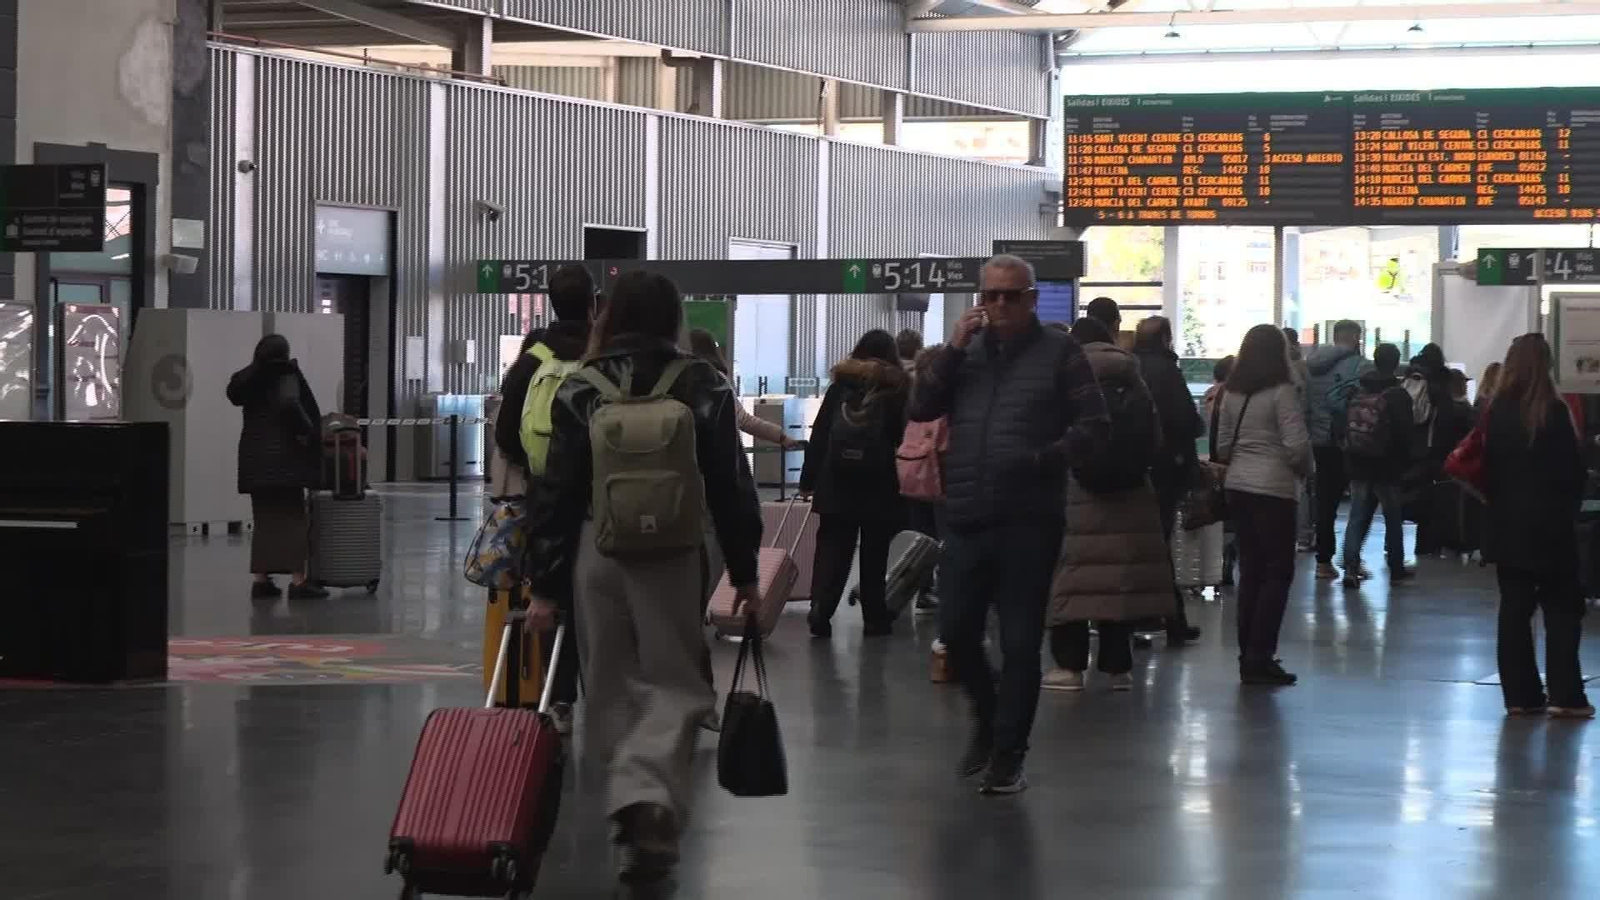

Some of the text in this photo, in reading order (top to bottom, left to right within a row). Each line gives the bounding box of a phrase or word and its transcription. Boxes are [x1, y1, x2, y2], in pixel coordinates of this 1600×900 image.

[1066, 98, 1095, 107] Salidas
[1353, 94, 1382, 102] Salidas
[1068, 135, 1093, 143] 11:15
[1094, 134, 1114, 143] SANT
[1118, 134, 1148, 142] VICENT
[1152, 134, 1182, 142] CENTRE
[1183, 134, 1194, 142] C3
[1382, 131, 1419, 139] CALLOSA
[1423, 130, 1435, 139] DE
[1438, 130, 1471, 139] SEGURA
[1477, 130, 1487, 138] C1
[1559, 129, 1571, 137] 12
[1068, 145, 1093, 153] 11:20
[1094, 145, 1128, 153] CALLOSA
[1132, 145, 1144, 153] DE
[1147, 144, 1177, 153] SEGURA
[1183, 144, 1192, 153] C1
[1264, 144, 1270, 152] 5
[1382, 142, 1403, 150] SANT
[1408, 142, 1439, 150] VICENT
[1444, 141, 1476, 150] CENTRE
[1477, 141, 1489, 150] C3
[1559, 140, 1570, 149] 11
[1094, 156, 1124, 164] MADRID
[1272, 154, 1302, 163] ACCESO
[1306, 154, 1343, 163] ABIERTO
[1382, 153, 1424, 162] VALENCIA
[1428, 152, 1449, 161] EST.
[1068, 166, 1093, 175] 11:47
[1094, 166, 1128, 175] VILLENA
[1183, 166, 1202, 174] REG.
[1382, 164, 1414, 173] MURCIA
[1418, 164, 1433, 172] DEL
[1438, 164, 1471, 172] CARMEN
[1477, 163, 1494, 172] AVE
[1094, 177, 1124, 185] MURCIA
[1128, 177, 1143, 185] DEL
[1147, 177, 1177, 185] CARMEN
[1183, 176, 1192, 185] C1
[1260, 176, 1269, 185] 11
[1354, 175, 1381, 184] 14:10
[1382, 175, 1414, 183] MURCIA
[1418, 174, 1433, 183] DEL
[1438, 174, 1471, 183] CARMEN
[1477, 174, 1487, 183] C1
[1559, 173, 1570, 182] 11
[1068, 188, 1093, 196] 12:41
[1094, 188, 1114, 196] SANT
[1118, 188, 1148, 196] VICENT
[1152, 187, 1182, 196] CENTRE
[1183, 187, 1194, 196] C3
[1354, 186, 1381, 195] 14:17
[1382, 186, 1419, 195] VILLENA
[1477, 185, 1498, 194] REG.
[1518, 185, 1547, 194] 14475
[1094, 198, 1124, 207] MURCIA
[1128, 198, 1143, 207] DEL
[1147, 198, 1177, 207] CARMEN
[1183, 198, 1208, 207] AVANT
[1354, 197, 1381, 205] 14:35
[1382, 197, 1414, 205] MADRID
[1477, 196, 1494, 205] AVE
[1534, 209, 1567, 218] ACCESO
